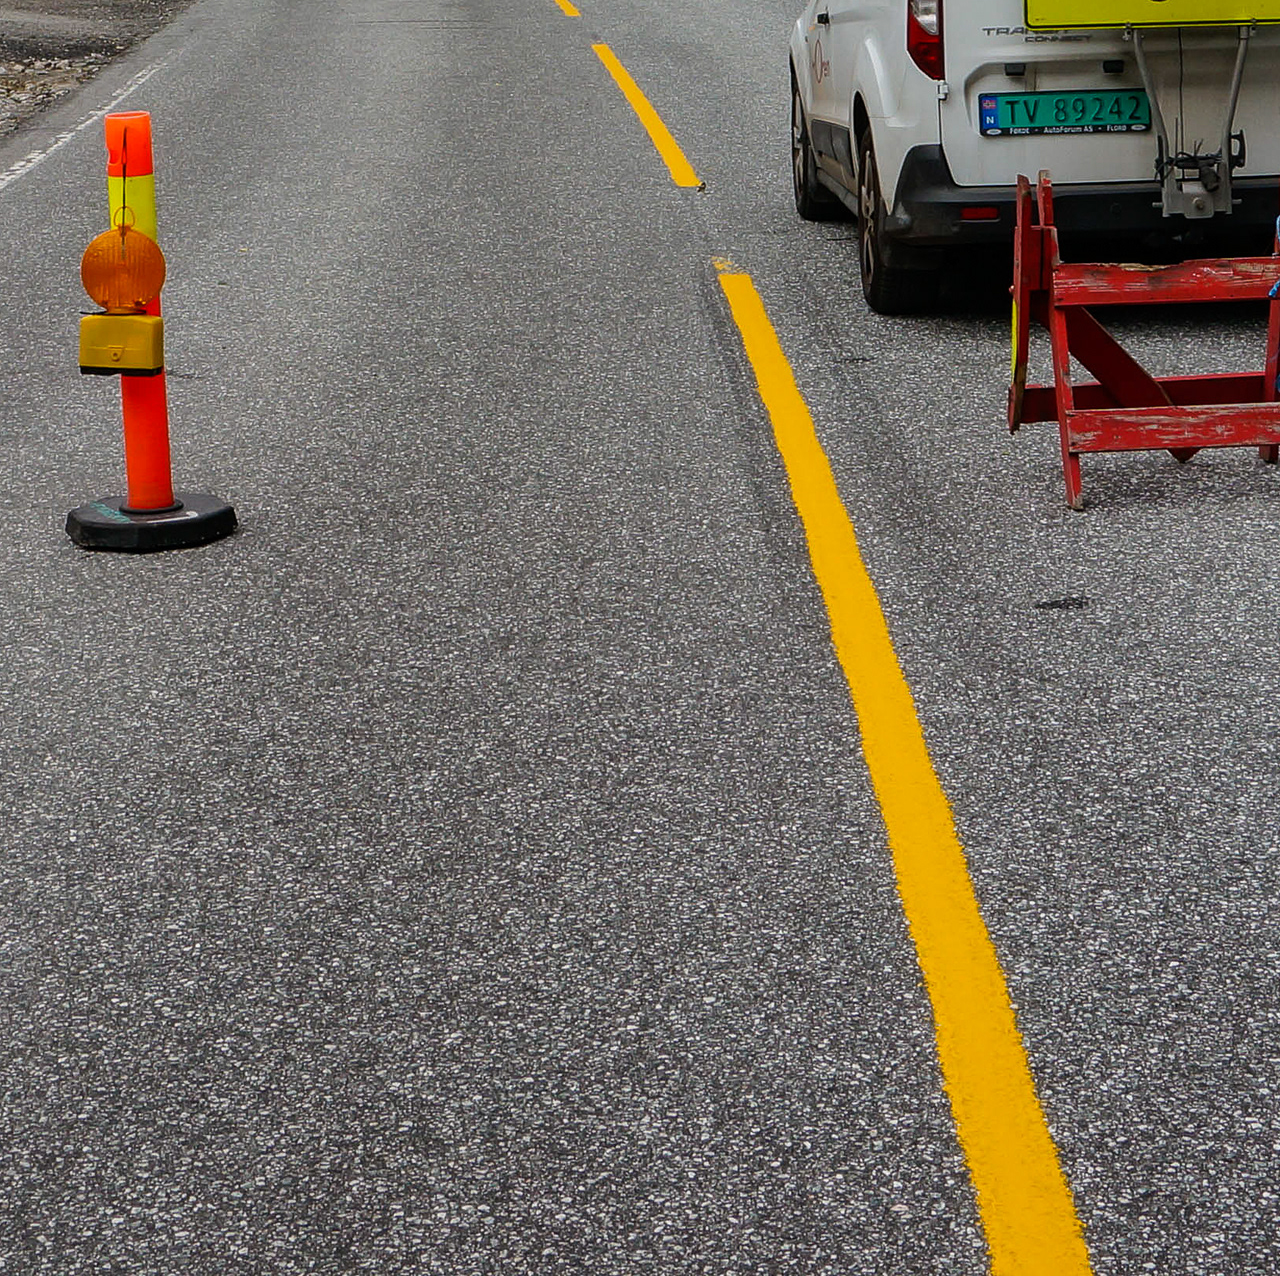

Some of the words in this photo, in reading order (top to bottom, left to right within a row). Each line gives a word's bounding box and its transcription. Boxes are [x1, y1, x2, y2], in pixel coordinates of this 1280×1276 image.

[1005, 98, 1040, 125] TV
[1053, 96, 1142, 123] 89242
[986, 116, 994, 124] N
